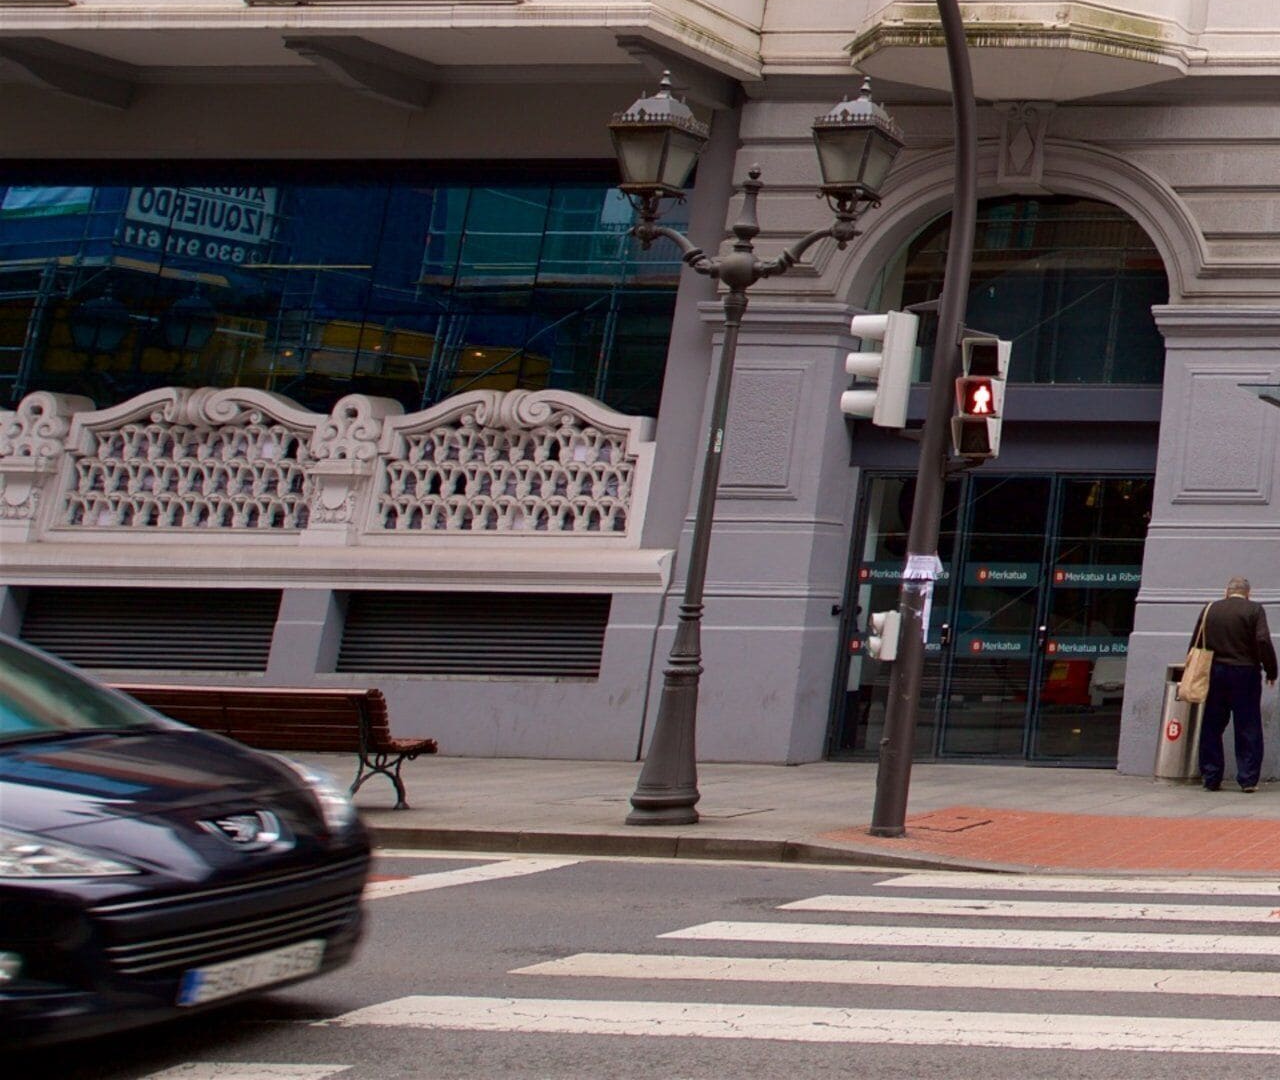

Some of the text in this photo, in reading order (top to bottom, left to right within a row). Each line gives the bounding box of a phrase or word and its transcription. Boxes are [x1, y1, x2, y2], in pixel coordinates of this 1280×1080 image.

[989, 571, 1028, 580] Merkatua
[1065, 572, 1105, 581] Merkatua
[1107, 572, 1117, 581] La
[1119, 572, 1141, 581] Riber
[982, 641, 1021, 650] Merkatua
[1057, 643, 1097, 652] Merkatua
[1099, 643, 1109, 652] La
